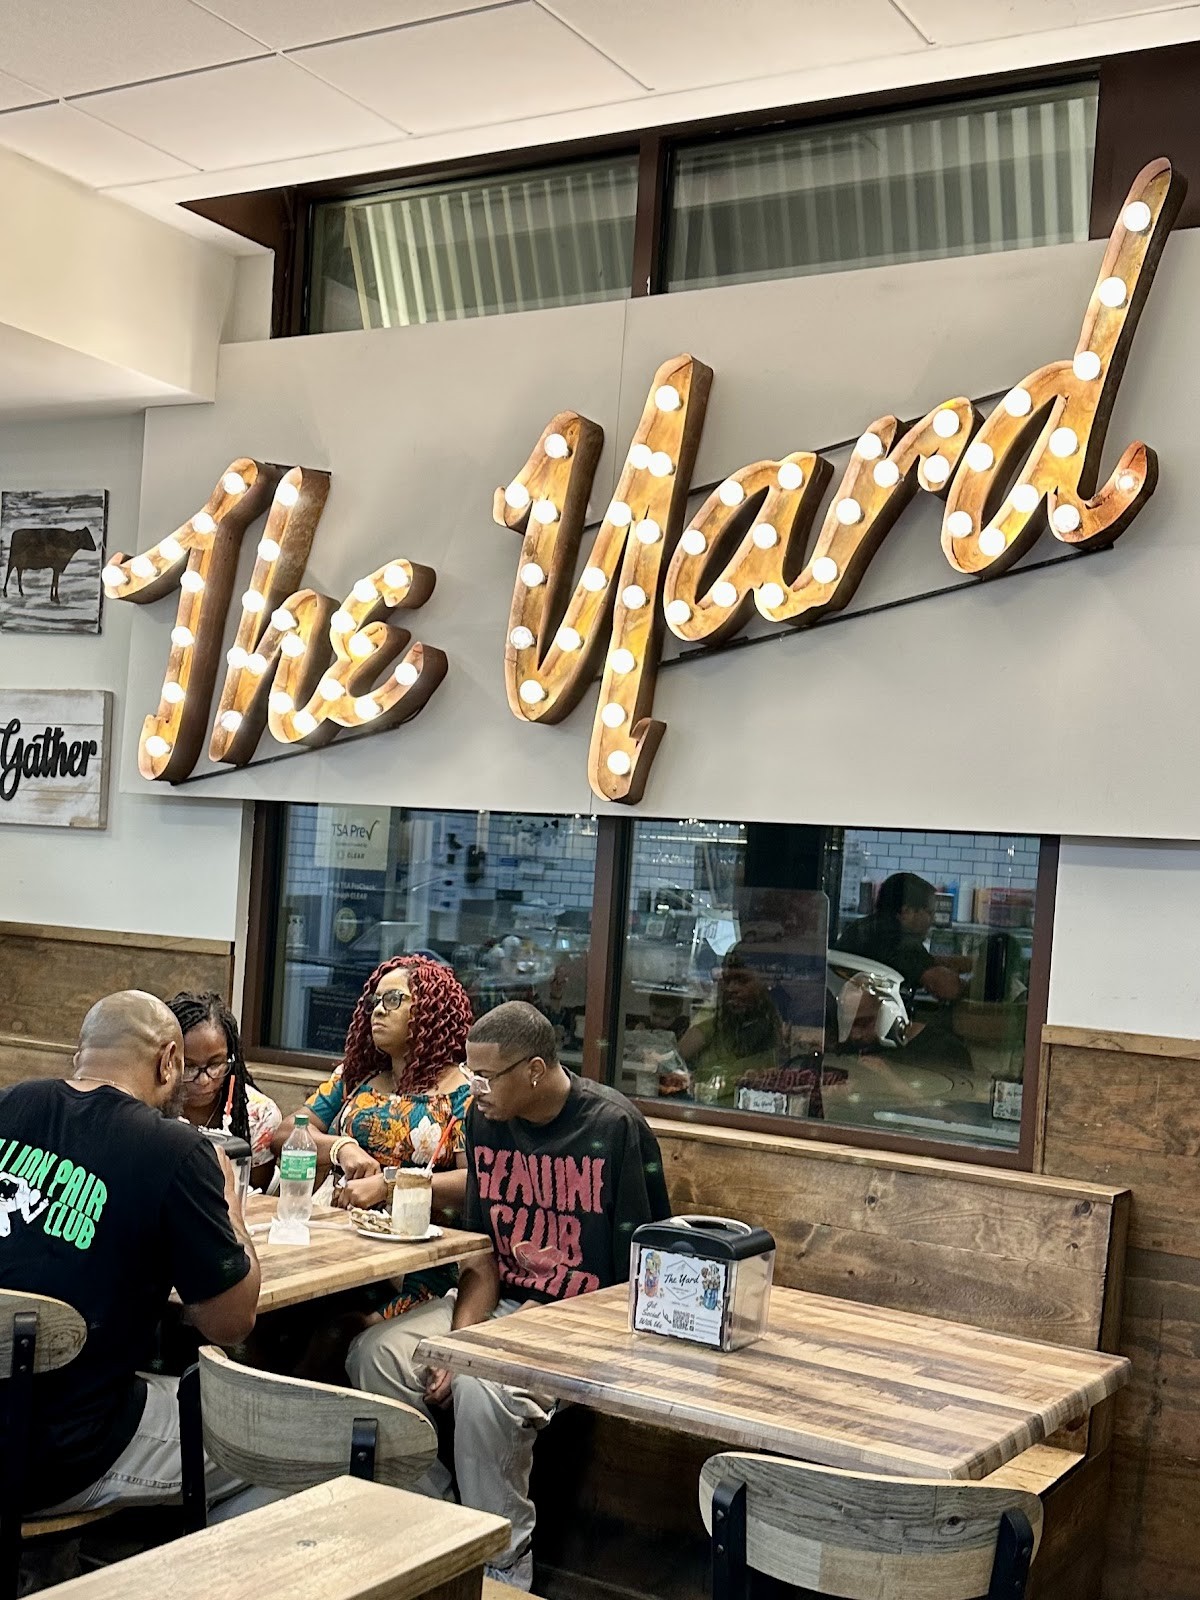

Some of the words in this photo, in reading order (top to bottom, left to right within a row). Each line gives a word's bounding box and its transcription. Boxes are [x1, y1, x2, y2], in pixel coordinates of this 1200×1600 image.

[102, 457, 448, 785] The
[493, 157, 1188, 805] Yard
[0, 718, 97, 801] Gather
[331, 823, 348, 837] TSA
[47, 1159, 107, 1222] PAIR
[43, 1201, 95, 1250] CLUB
[490, 1204, 583, 1268] CLUB
[664, 1273, 677, 1284] The
[679, 1273, 700, 1287] Yard
